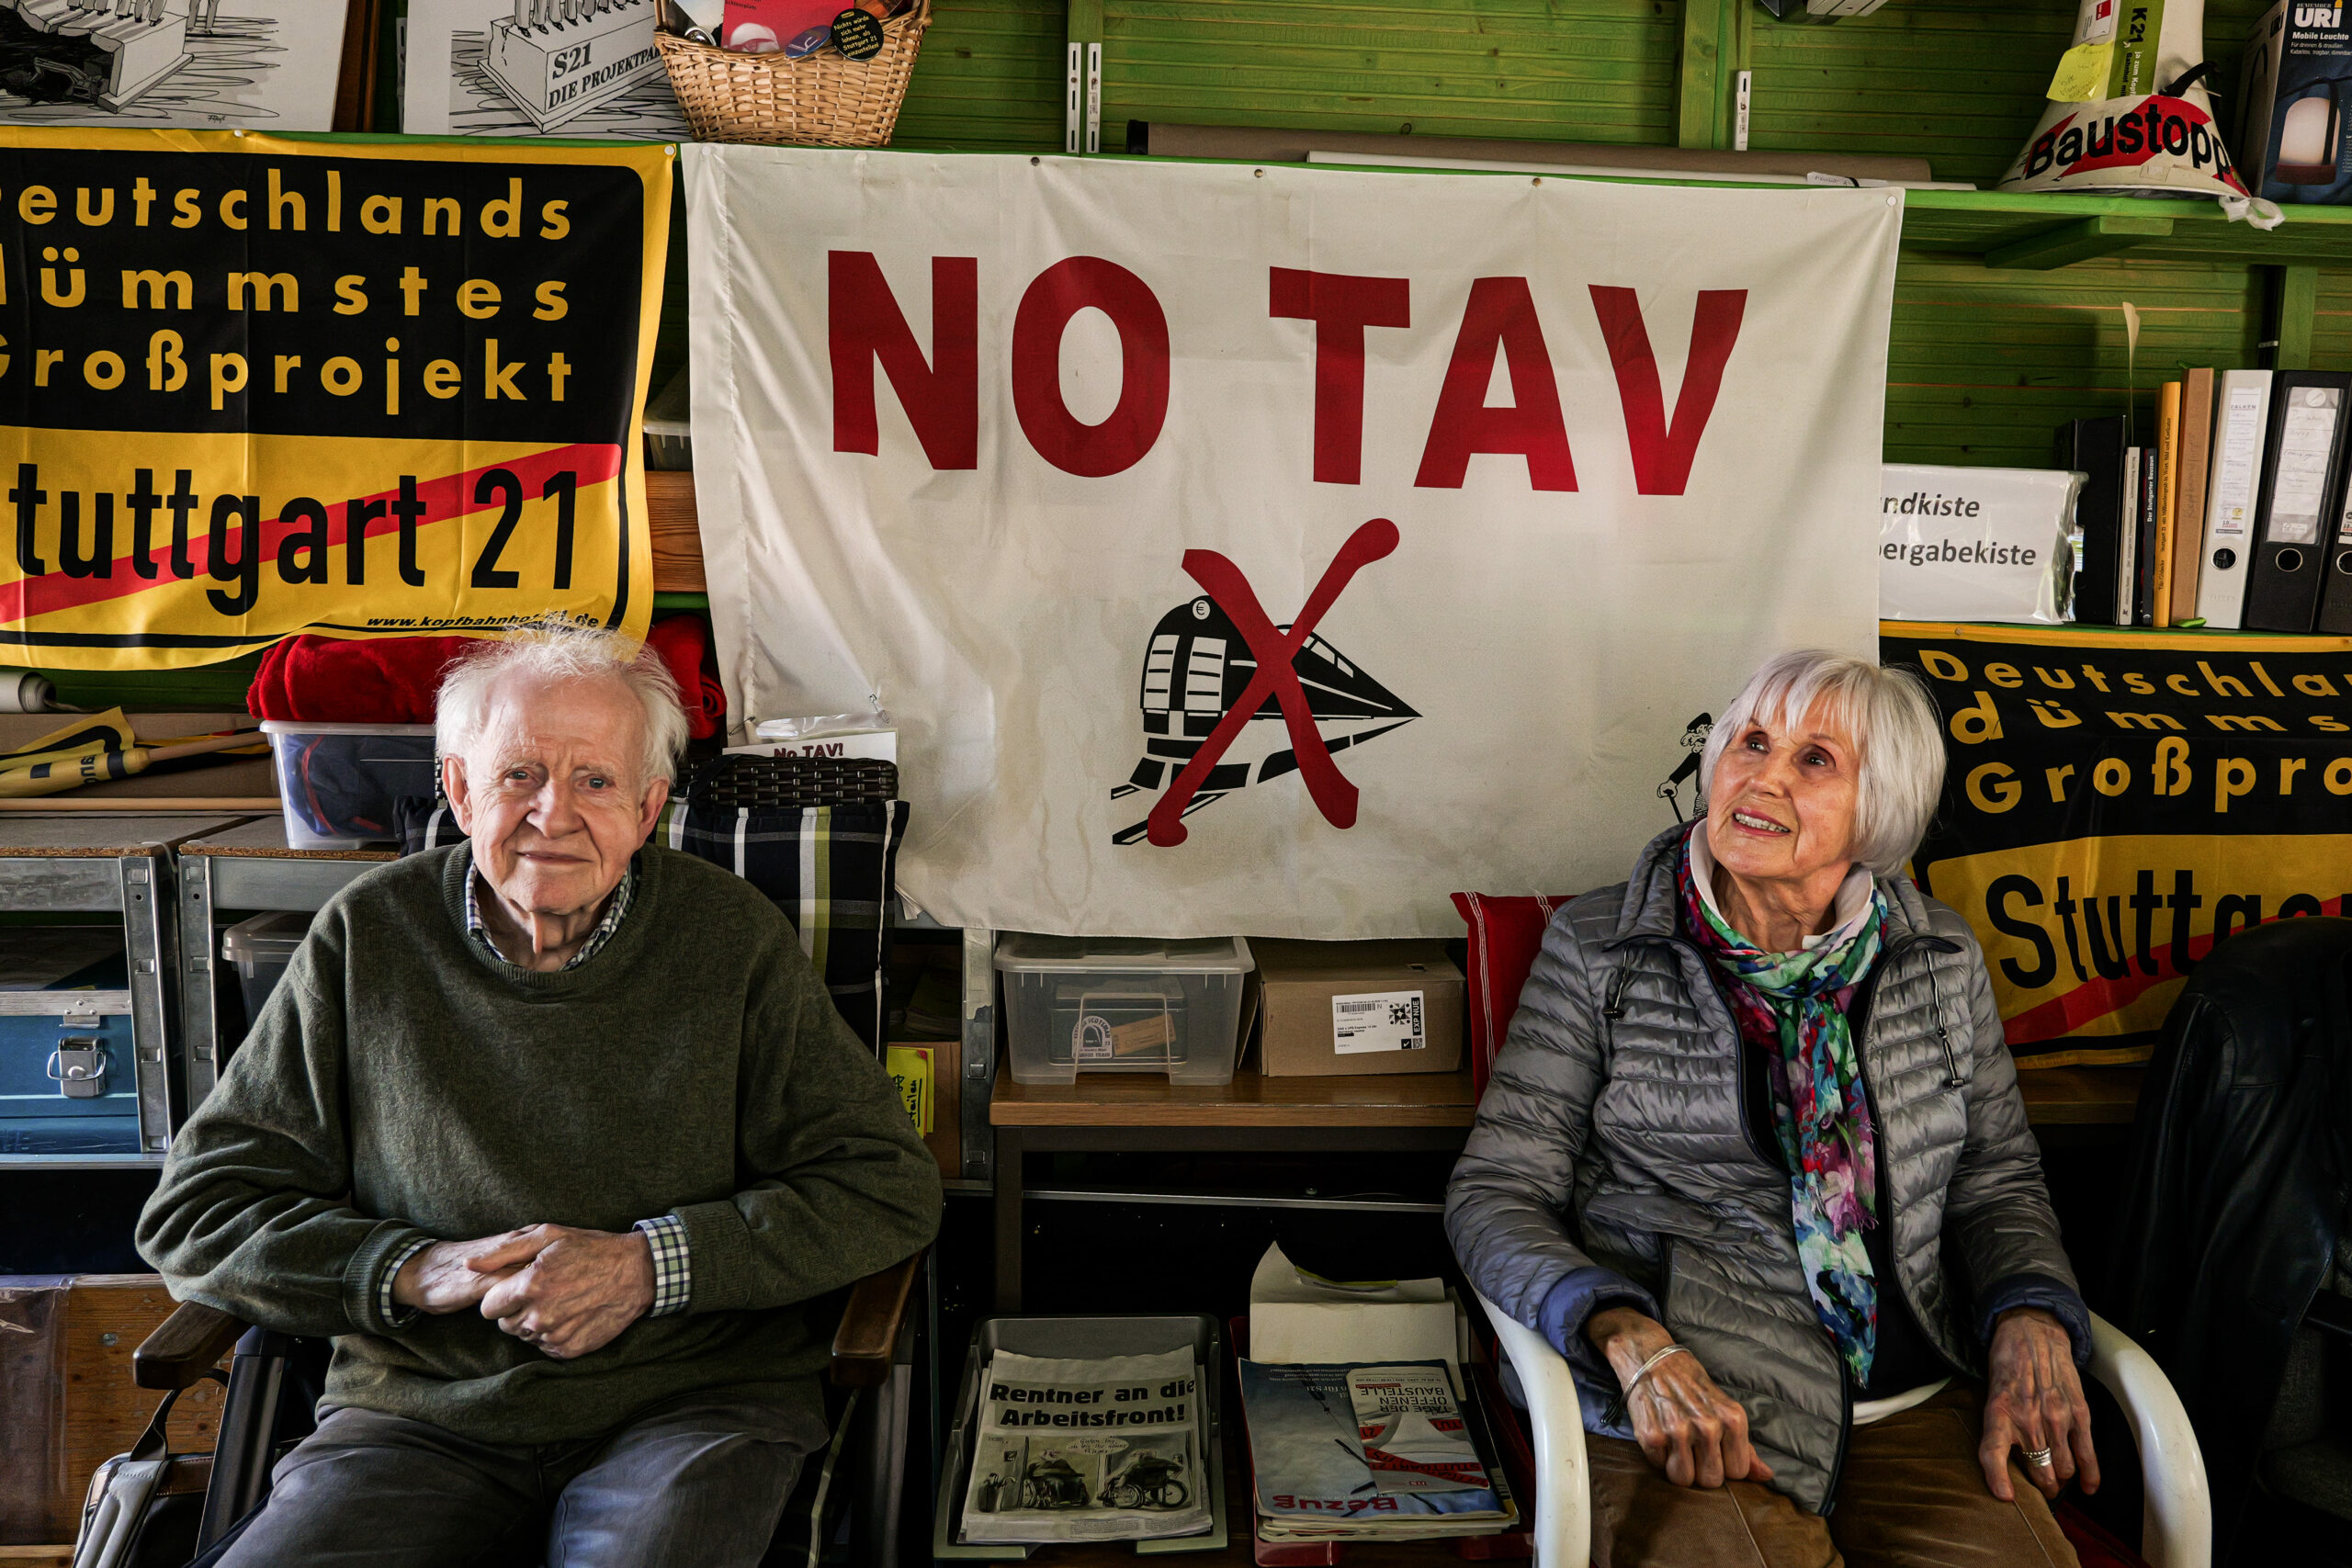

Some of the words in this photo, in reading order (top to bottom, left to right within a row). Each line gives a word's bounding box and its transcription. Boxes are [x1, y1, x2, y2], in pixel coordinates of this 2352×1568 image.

[833, 21, 853, 31] Nichts
[2128, 7, 2148, 43] K21
[2320, 32, 2349, 40] Leuchte
[843, 38, 868, 51] Stuttgart
[551, 41, 592, 80] S21
[2122, 52, 2132, 83] Bahnhof
[548, 80, 579, 109] DIE
[2130, 77, 2139, 96] Kopf
[2024, 104, 2231, 182] Baustopp
[0, 169, 571, 241] eutschlands
[0, 243, 571, 321] ümmstes
[0, 329, 572, 415] roßprojekt
[828, 249, 1170, 479] NO
[1269, 265, 1748, 496] TAV
[1881, 491, 1980, 517] ndkiste
[8, 463, 426, 616] tuttgart
[470, 468, 578, 591] 21
[1879, 539, 2037, 567] ergabekiste
[1919, 649, 2352, 697] Deutschla
[774, 748, 797, 758] No
[802, 742, 843, 759] TAV!
[1985, 870, 2352, 989] Stutt
[989, 1382, 1104, 1404] Rentner
[1114, 1386, 1148, 1403] an
[1159, 1379, 1195, 1399] die
[1361, 1387, 1445, 1396] BAUSTELLE
[1380, 1396, 1448, 1405] OFFENEN
[1000, 1403, 1185, 1427] Arbeitsfront!
